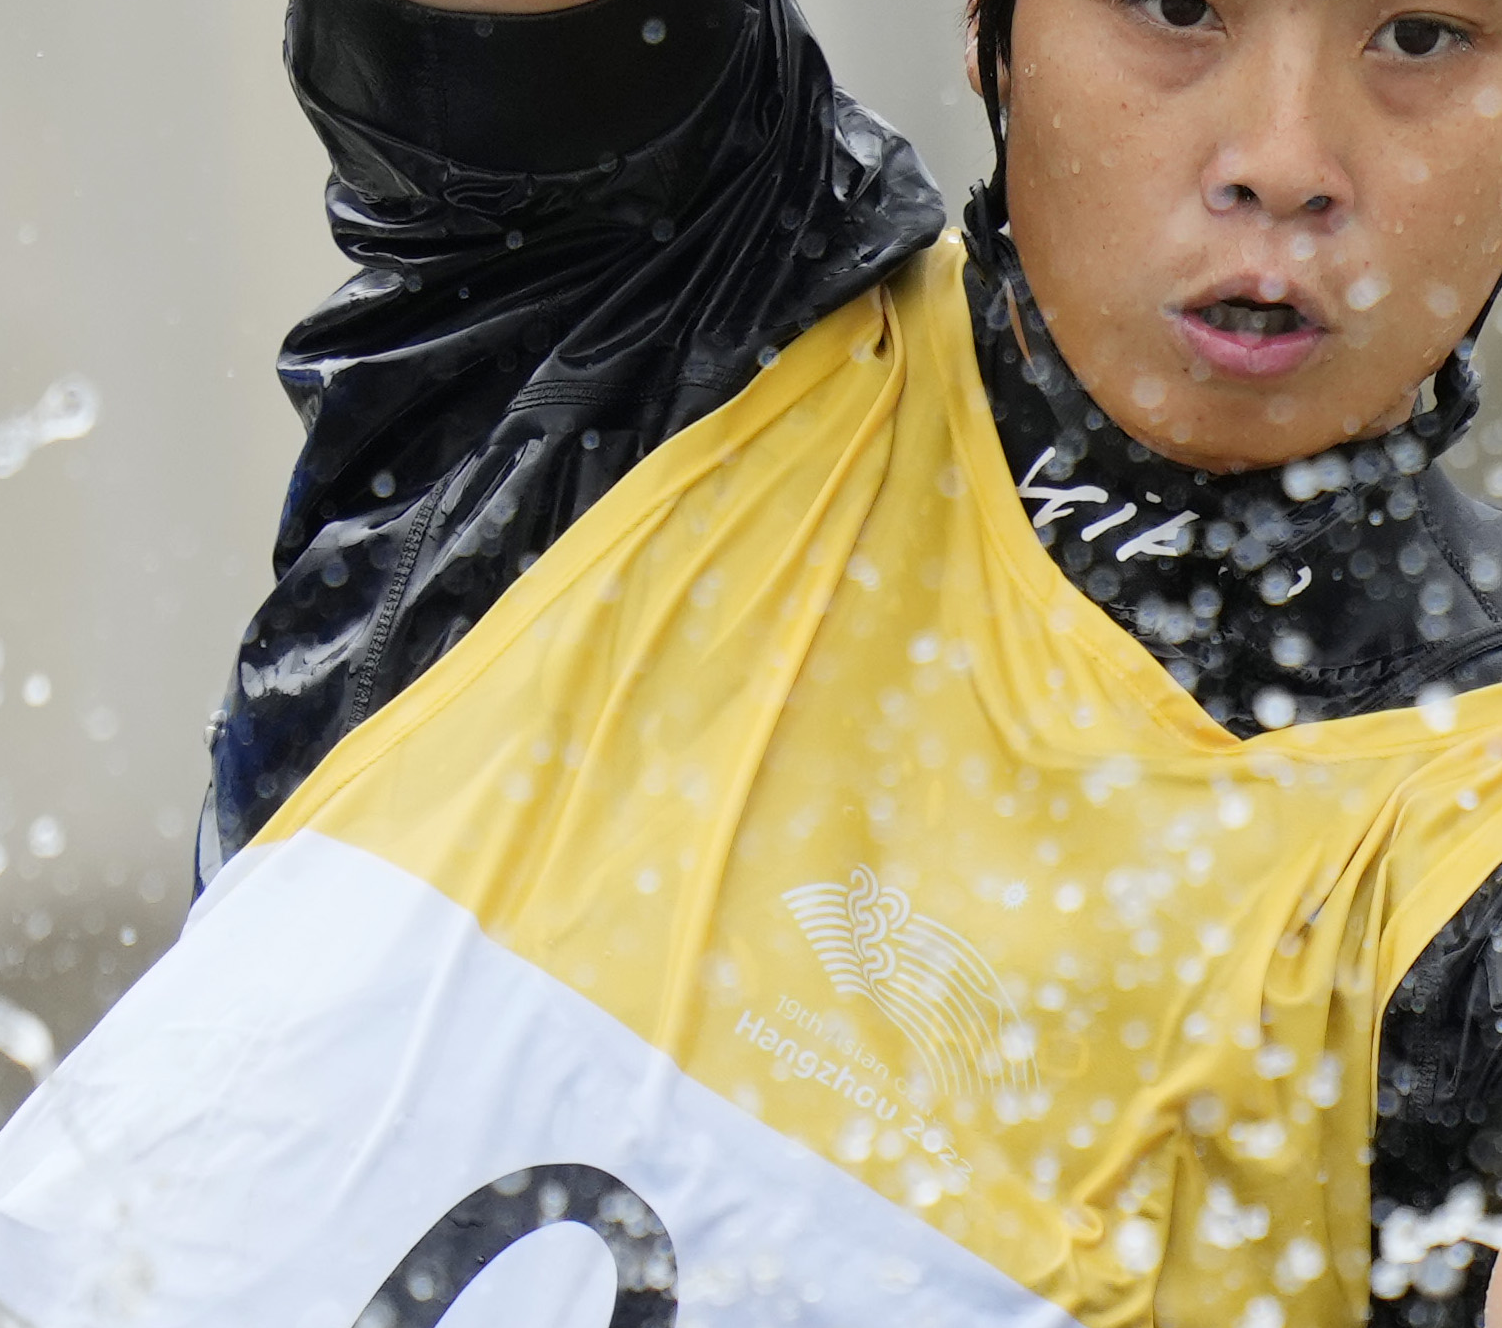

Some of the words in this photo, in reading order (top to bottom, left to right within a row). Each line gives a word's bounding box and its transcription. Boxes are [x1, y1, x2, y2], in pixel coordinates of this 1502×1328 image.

[734, 1009, 898, 1120] Hangzhou
[901, 1114, 973, 1181] 222
[776, 994, 824, 1036] 19th
[824, 1028, 890, 1080] Asian
